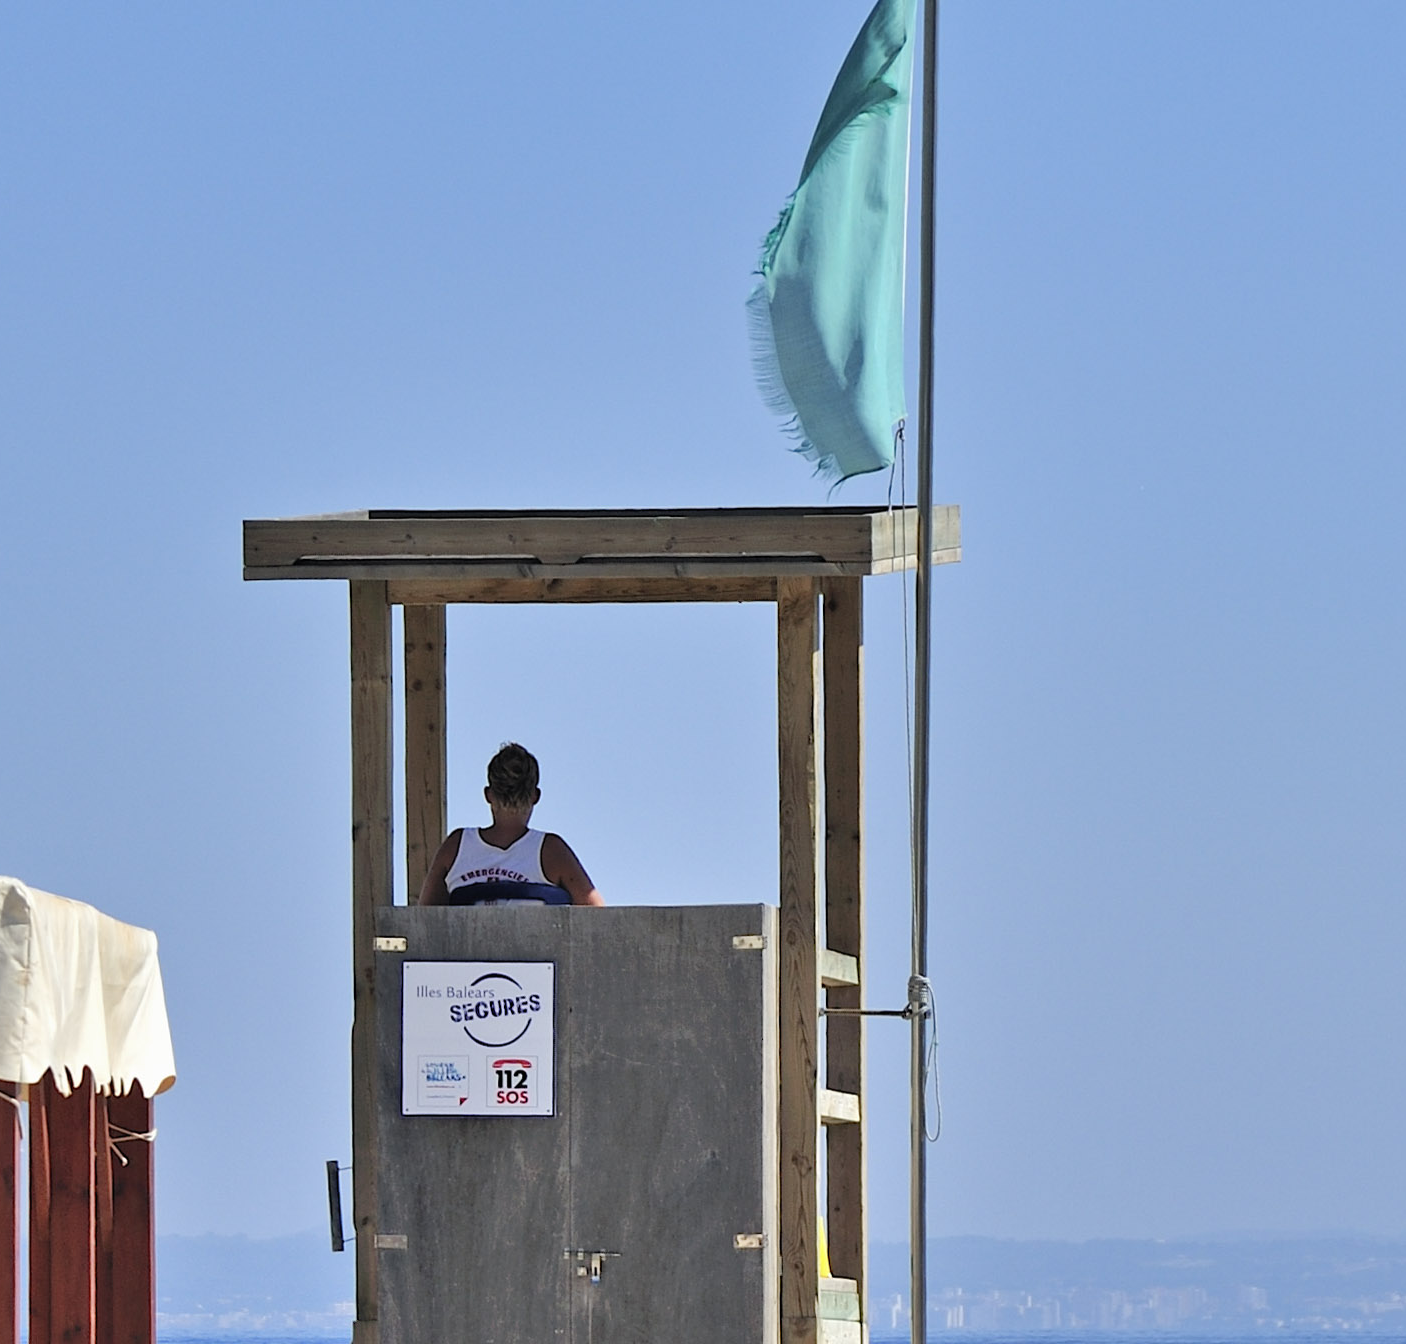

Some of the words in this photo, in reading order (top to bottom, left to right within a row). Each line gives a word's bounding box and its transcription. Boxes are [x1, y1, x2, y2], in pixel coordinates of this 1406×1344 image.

[416, 985, 442, 999] Illes
[447, 985, 495, 999] Balears
[450, 994, 541, 1023] SEGURES
[495, 1070, 528, 1089] 112
[496, 1091, 529, 1104] SOS
